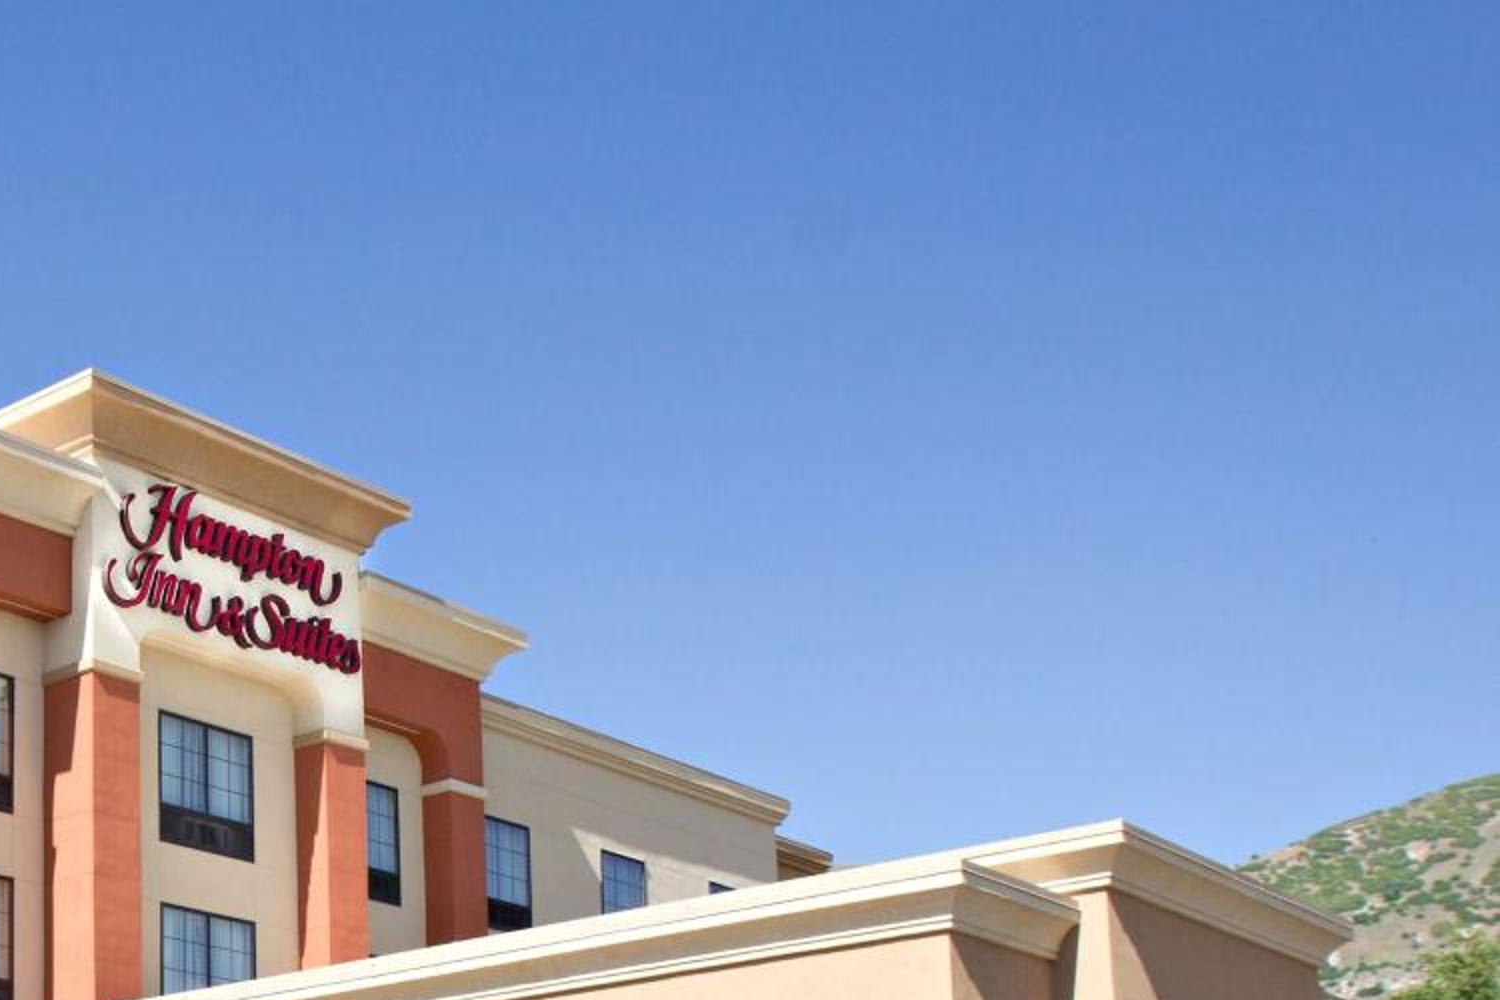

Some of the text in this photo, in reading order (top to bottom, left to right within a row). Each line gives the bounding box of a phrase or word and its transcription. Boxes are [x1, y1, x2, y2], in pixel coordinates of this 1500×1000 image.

[119, 483, 342, 606] Hampton
[102, 551, 221, 632] Inn
[245, 593, 361, 674] Suites
